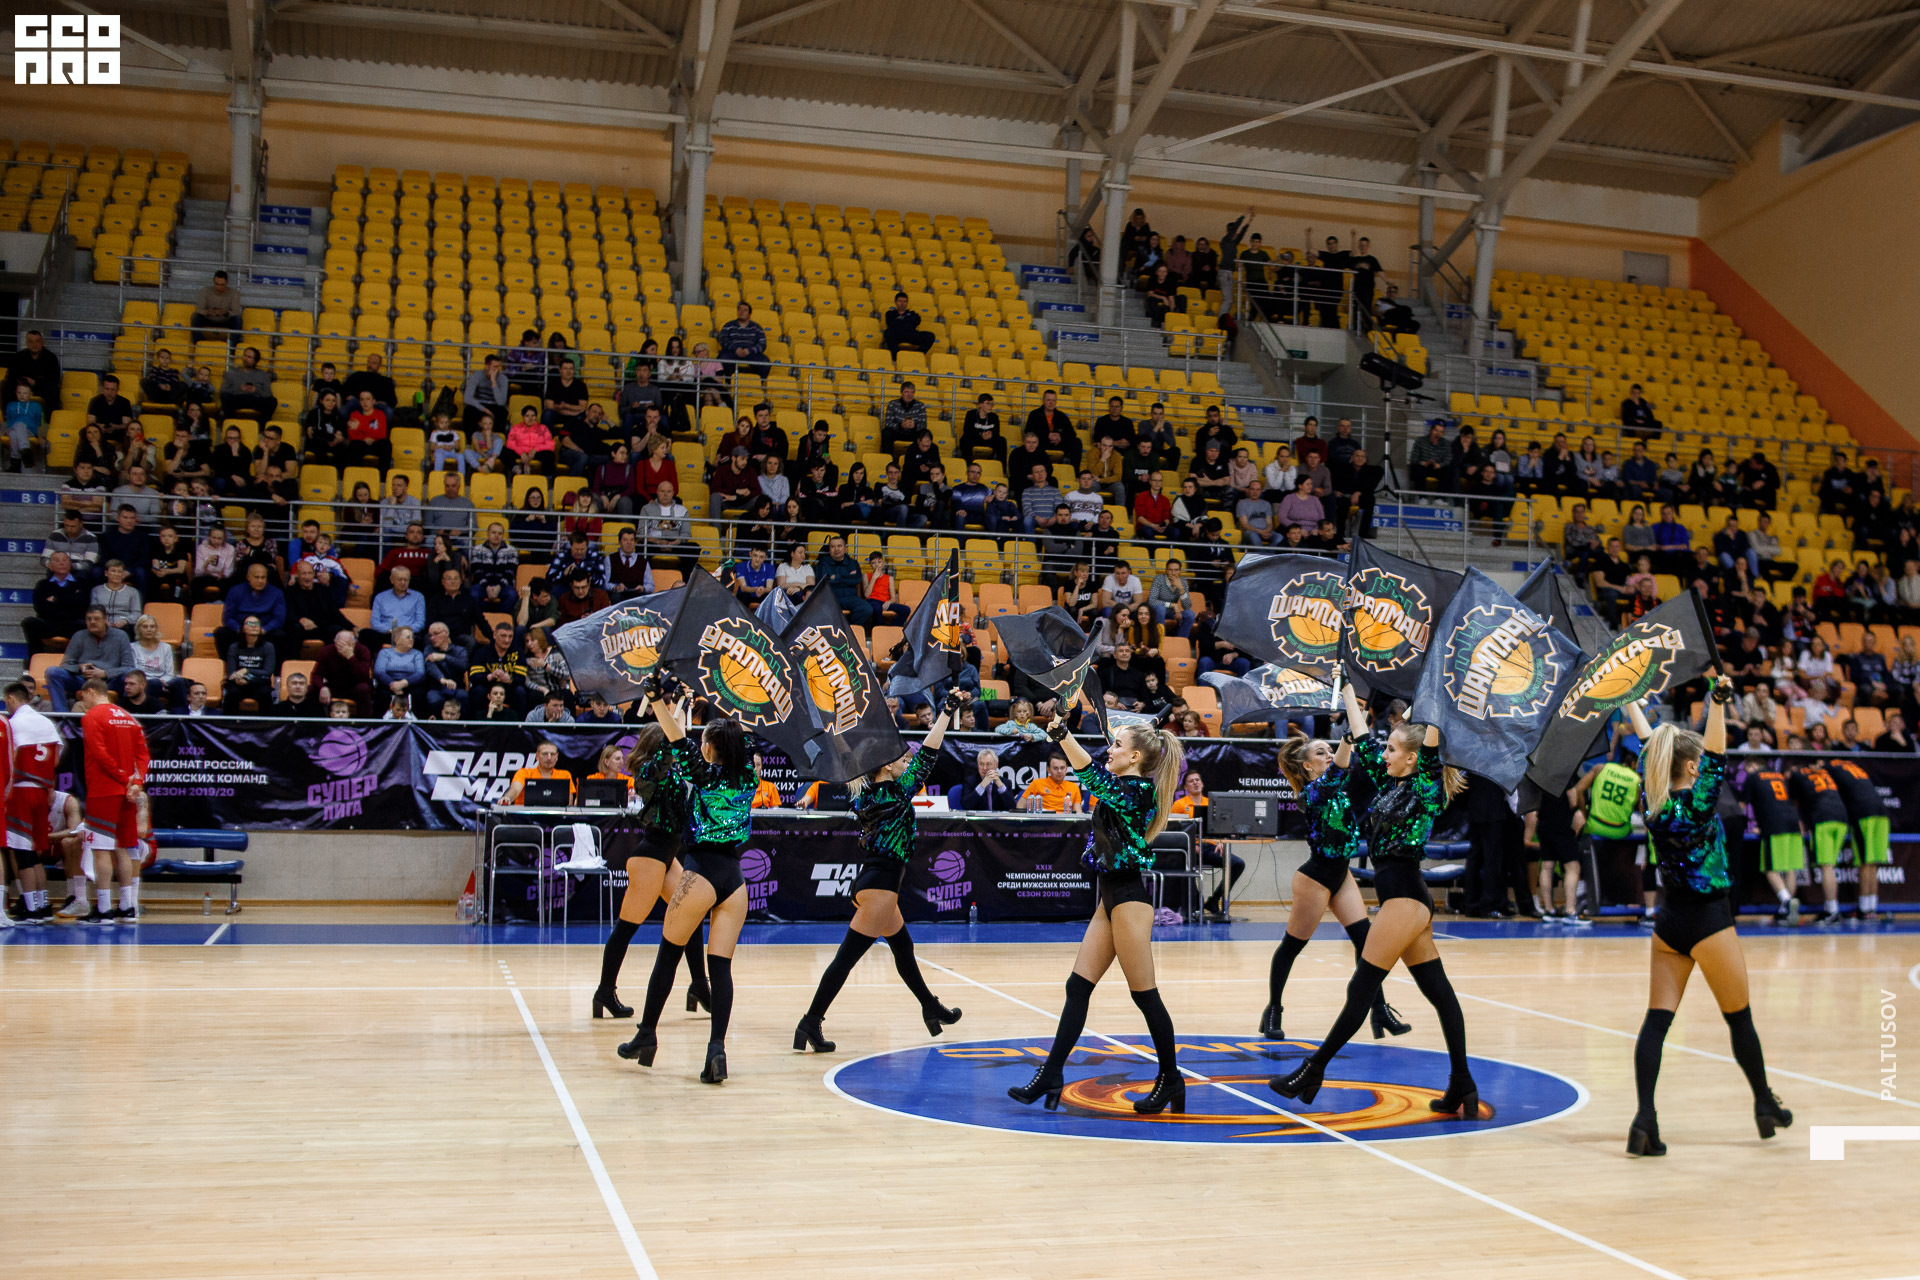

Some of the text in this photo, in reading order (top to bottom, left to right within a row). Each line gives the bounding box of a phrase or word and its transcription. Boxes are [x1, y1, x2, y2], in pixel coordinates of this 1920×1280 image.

[38, 493, 46, 504] 6
[25, 541, 33, 552] 5
[9, 591, 19, 601] 4
[698, 625, 793, 722] УРАЛМАШ
[797, 627, 857, 735] УРАЛМАШ
[34, 743, 47, 761] 5
[178, 746, 205, 756] XXIX
[204, 761, 254, 770] РОССИИ
[762, 756, 787, 765] XXIX
[156, 773, 214, 782] МУЖСКИХ
[217, 774, 268, 784] КОМАНД
[1239, 778, 1293, 787] ЧЕМПИОНА
[147, 787, 234, 797] СЕЗОН 2019/20
[307, 774, 378, 806] СУПЕР
[431, 776, 511, 802] МА
[1601, 780, 1628, 806] 98
[322, 801, 362, 821] ЛИГА
[1005, 872, 1082, 881] ЧЕМПИОНАТ РОССИИ
[997, 881, 1091, 890] СРЕДИ МУЖСКИХ КОМАНД
[927, 881, 972, 902] СУПЕР
[748, 898, 768, 911] ИГА
[937, 898, 962, 912] ЛИГА
